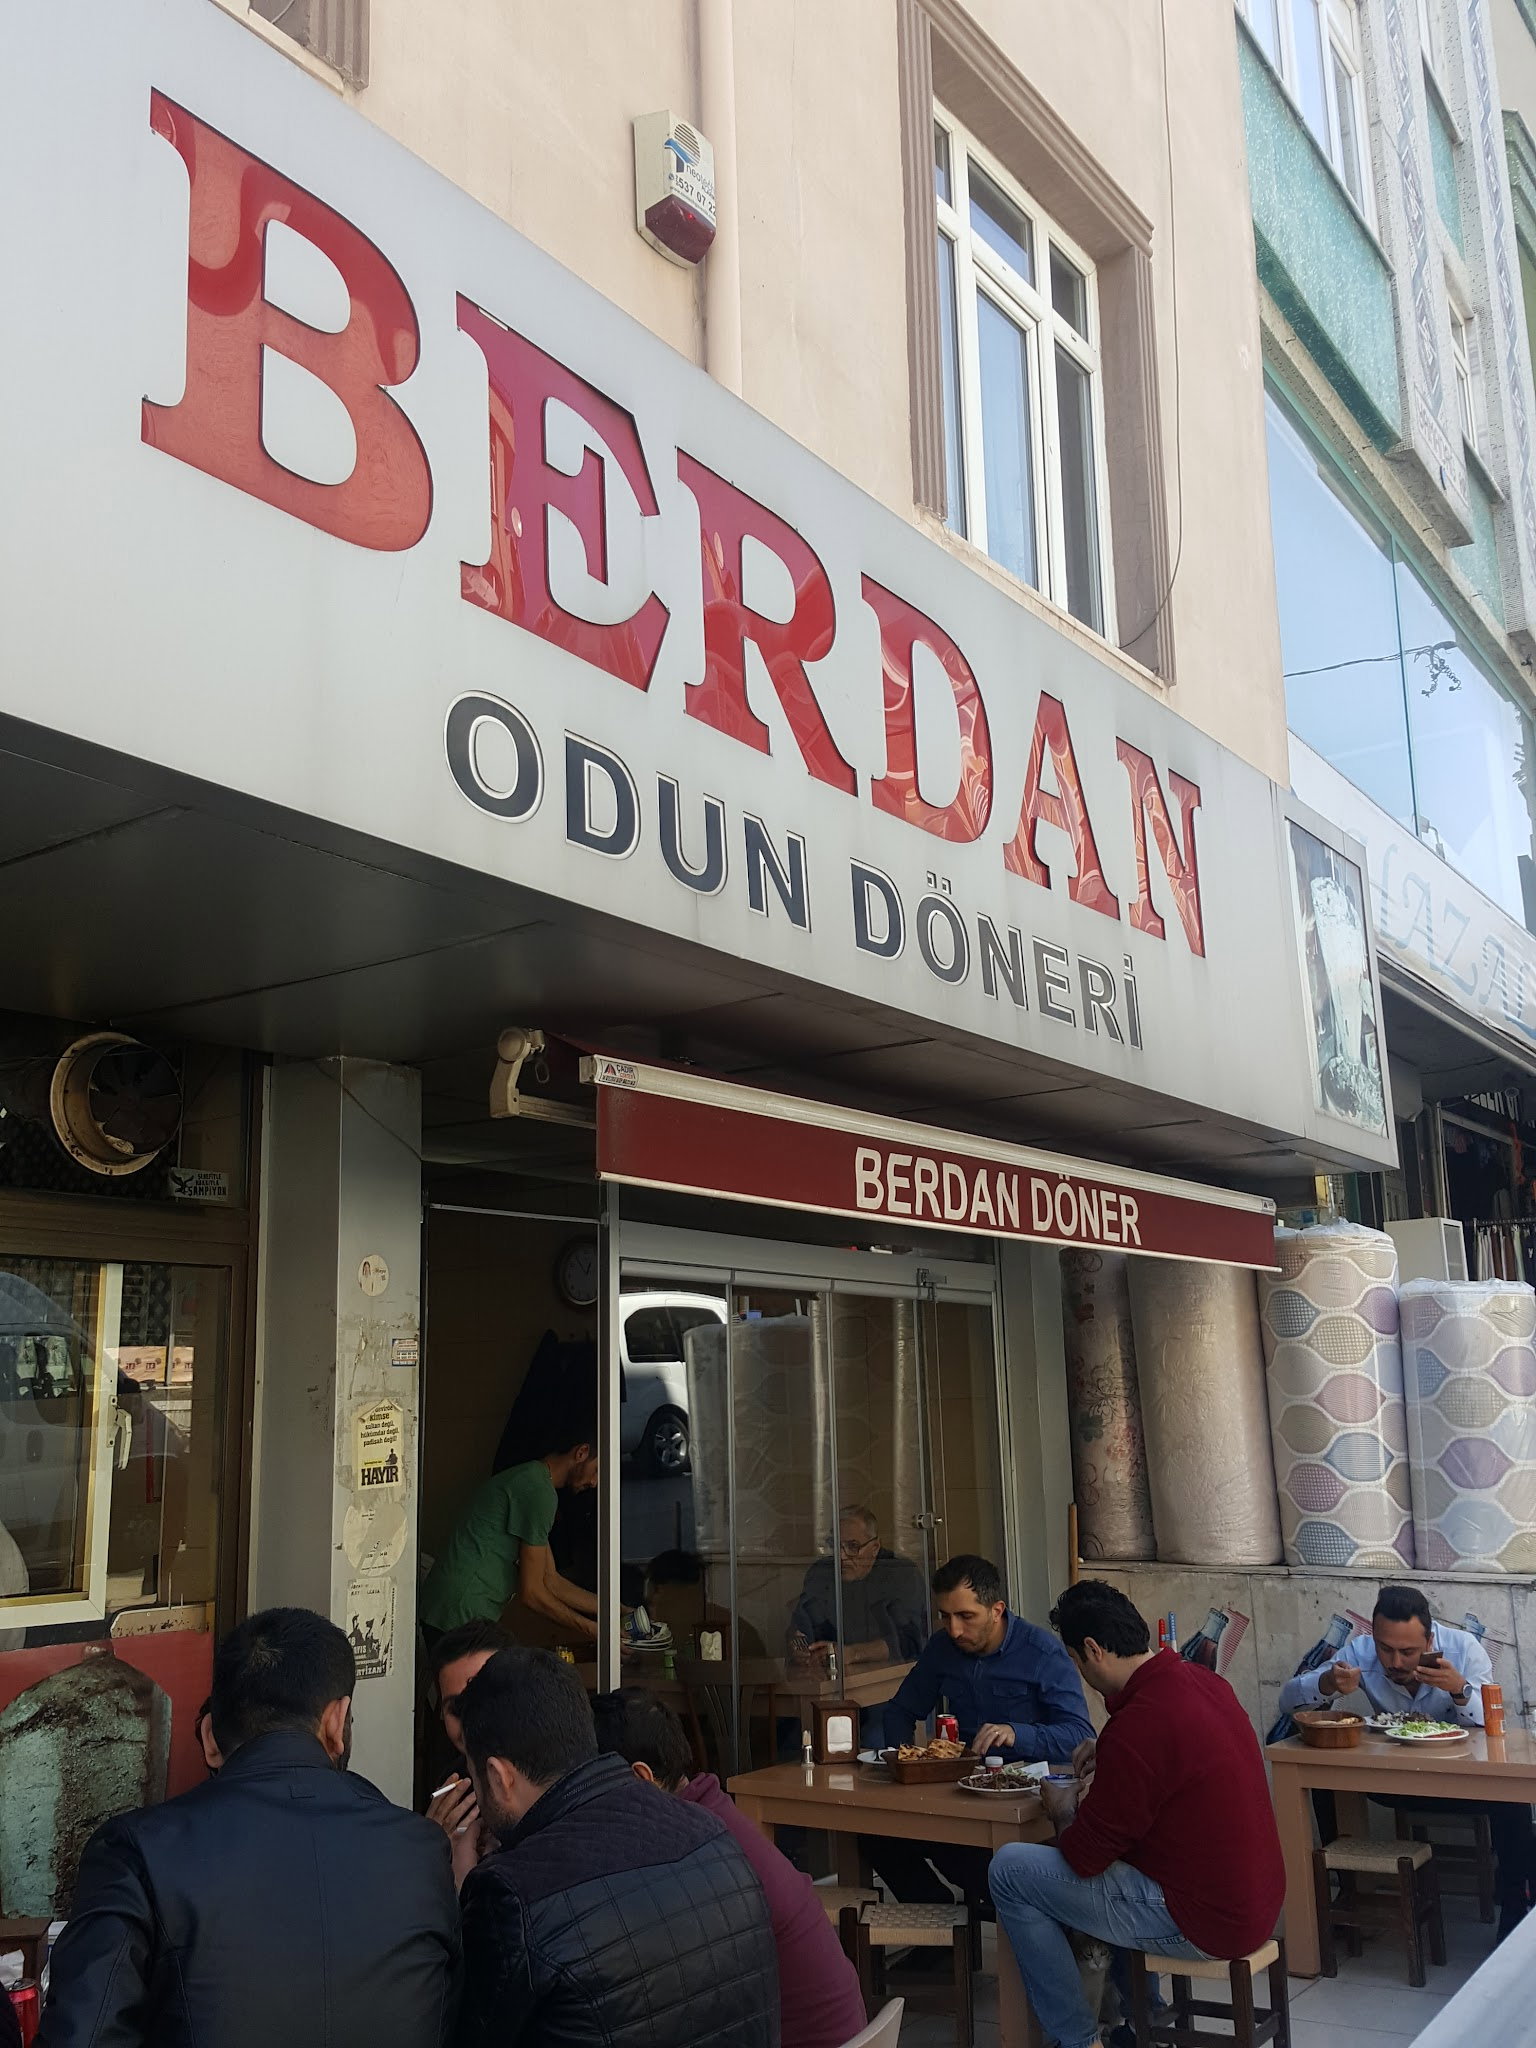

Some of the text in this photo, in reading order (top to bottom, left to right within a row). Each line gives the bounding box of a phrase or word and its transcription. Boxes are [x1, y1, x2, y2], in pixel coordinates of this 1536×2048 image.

[141, 87, 1206, 958] BERDAN
[444, 689, 1143, 1051] ODUN DÖNERİ
[855, 1146, 1142, 1246] BERDAN DÖNER
[361, 1466, 399, 1486] HAYIR
